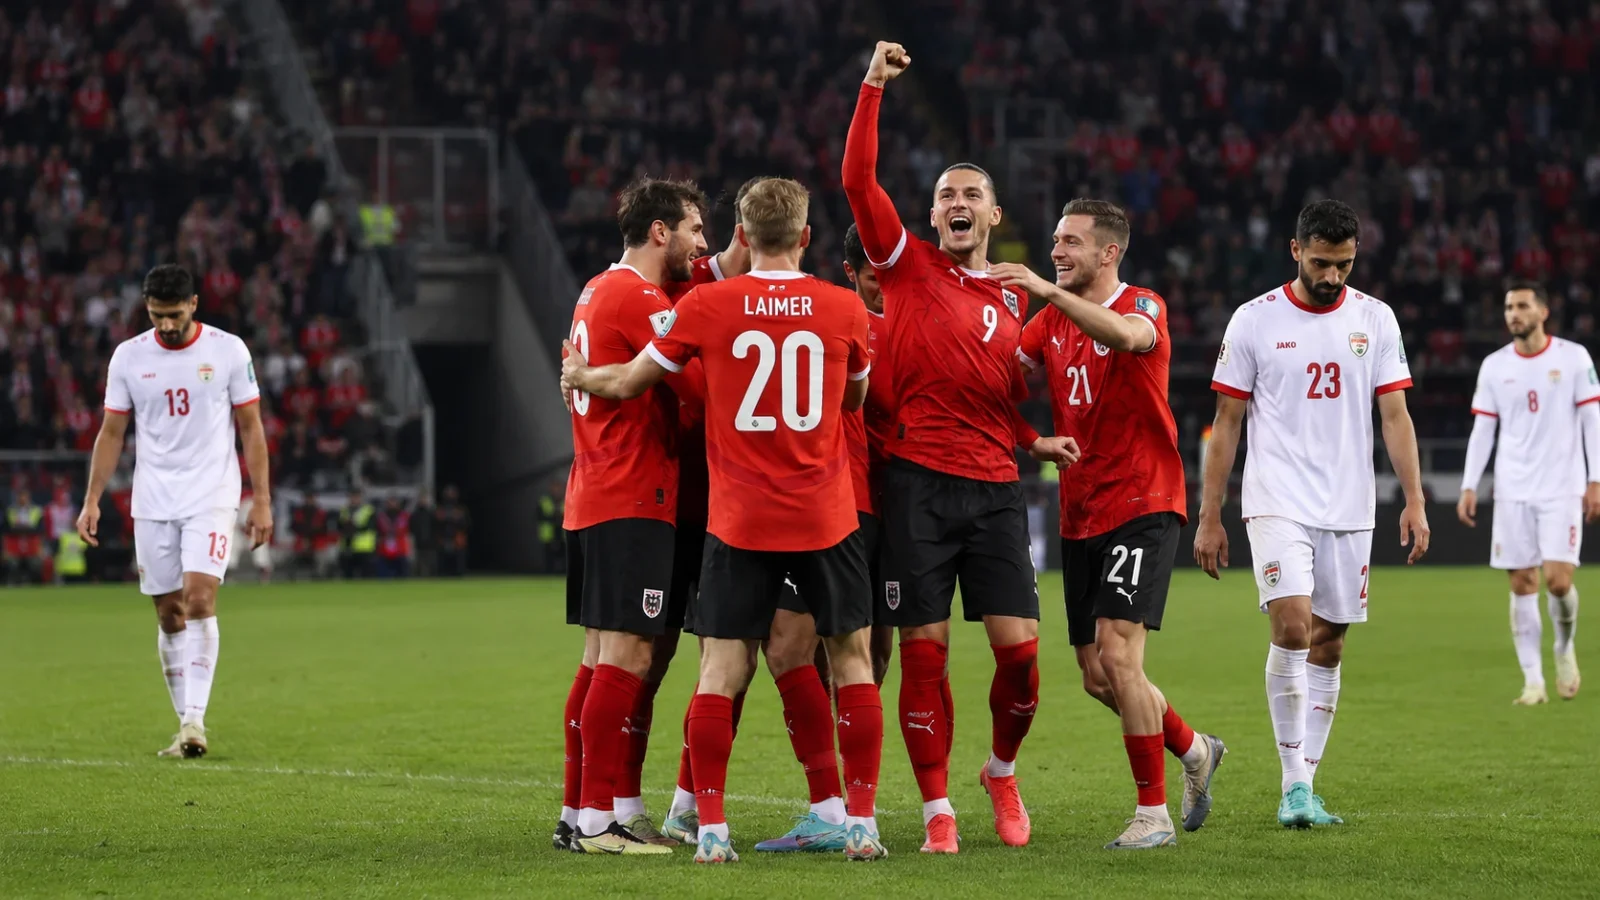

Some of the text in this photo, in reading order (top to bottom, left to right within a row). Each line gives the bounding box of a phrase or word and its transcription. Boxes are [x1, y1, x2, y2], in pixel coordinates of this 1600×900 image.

[744, 295, 813, 316] LAIMER
[982, 304, 998, 343] 9
[1276, 341, 1297, 349] JAKO
[732, 330, 825, 432] 20
[1066, 364, 1092, 406] 21
[1306, 362, 1341, 399] 23
[164, 388, 190, 417] 13
[1528, 390, 1539, 413] 8
[208, 531, 228, 560] 13
[1107, 544, 1144, 586] 21
